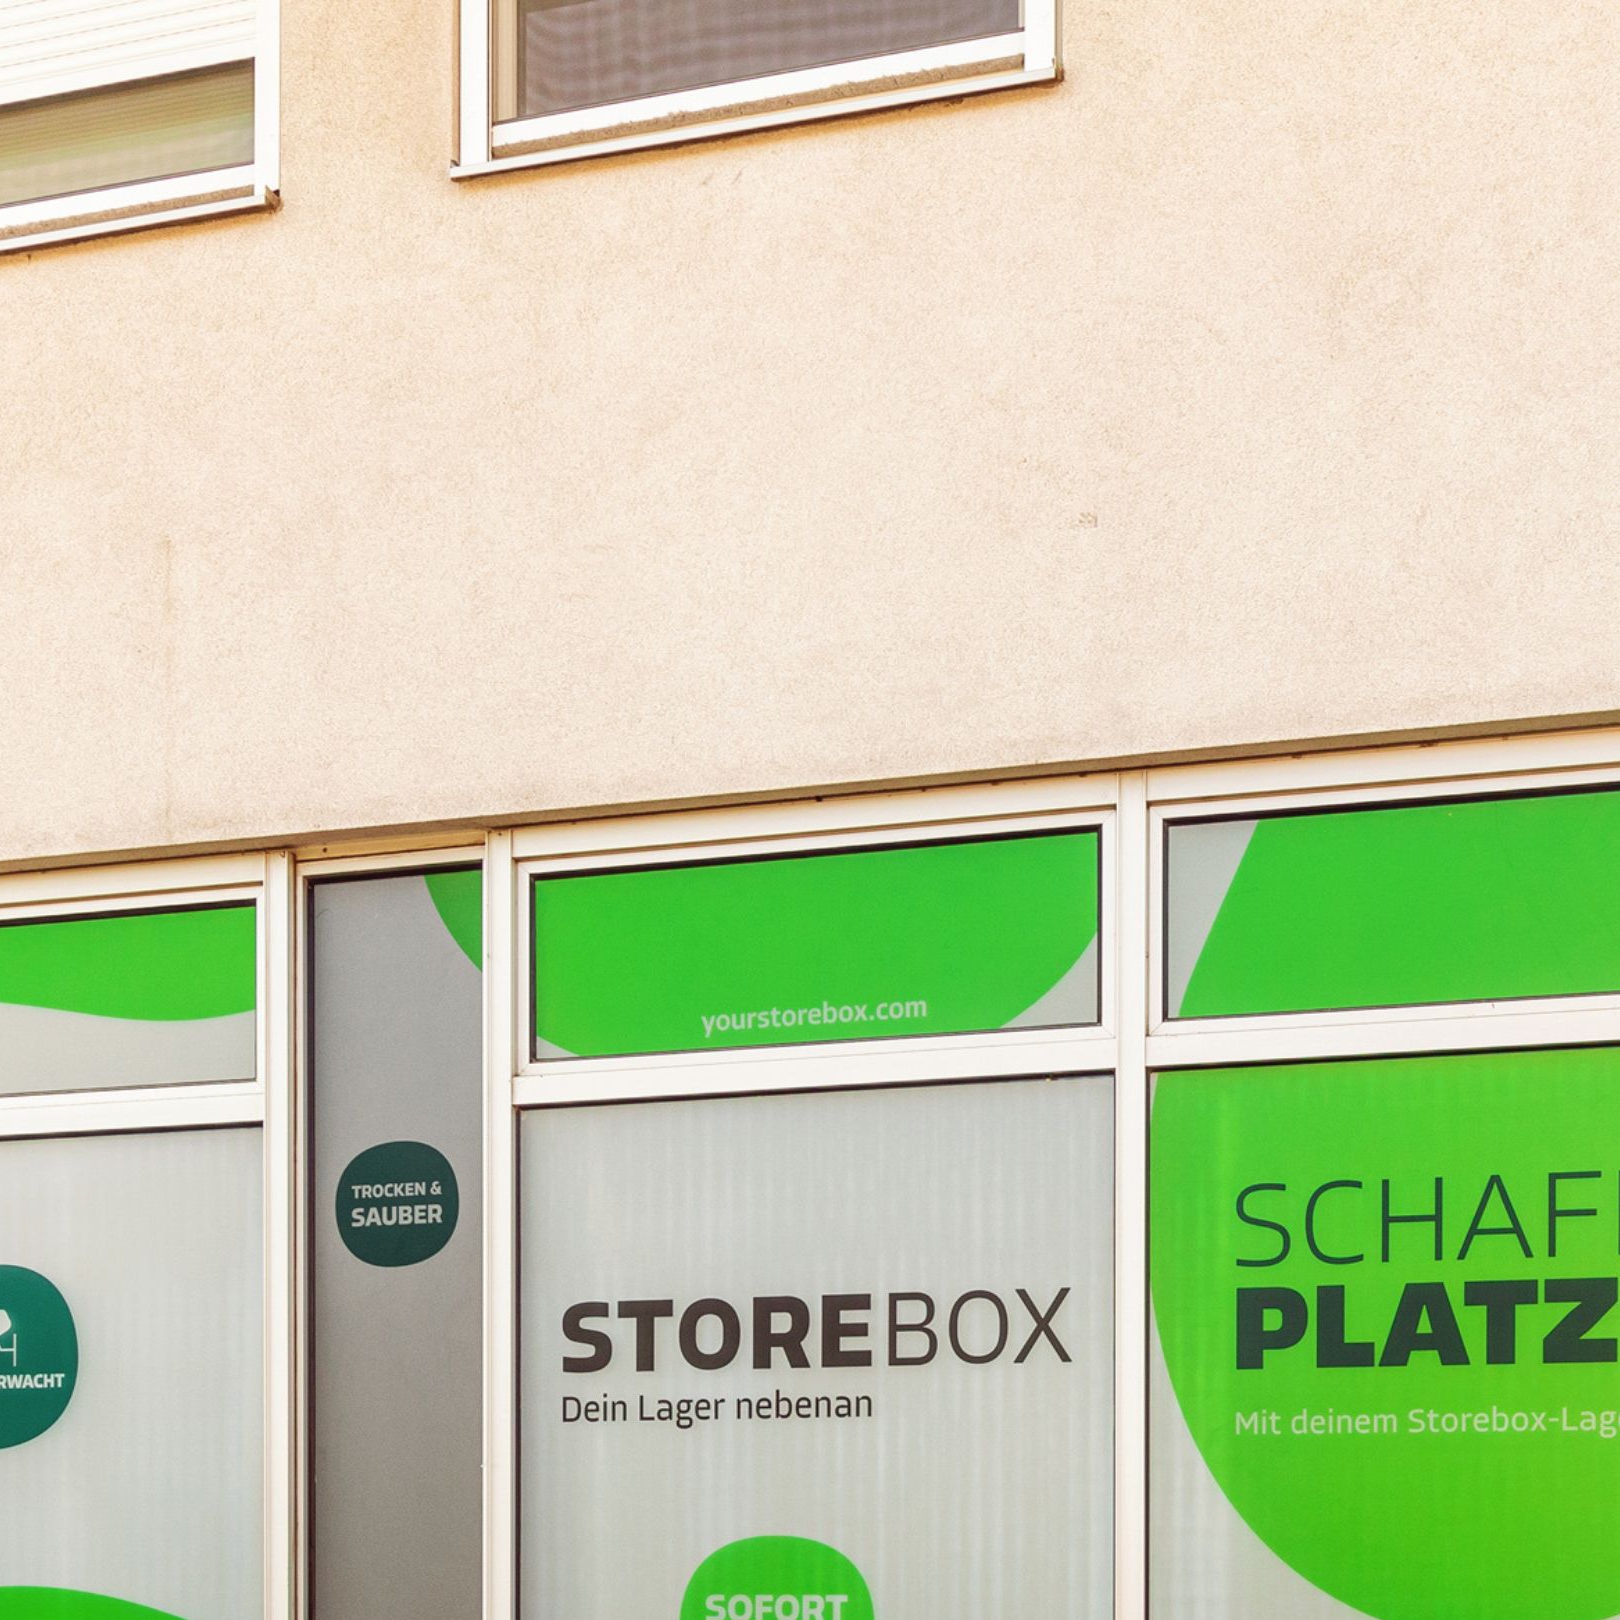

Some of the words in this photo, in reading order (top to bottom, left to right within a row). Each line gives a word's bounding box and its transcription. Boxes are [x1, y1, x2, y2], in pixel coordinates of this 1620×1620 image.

[701, 1000, 927, 1036] yourstorebox.com
[351, 1181, 426, 1199] TROCKEN
[430, 1181, 442, 1195] &
[351, 1203, 443, 1228] SAUBER
[561, 1286, 1073, 1374] STOREBOX
[561, 1393, 628, 1423] Dein
[638, 1394, 722, 1429] Lager
[736, 1388, 873, 1420] nebenan
[1235, 1408, 1282, 1436] Mit
[1291, 1407, 1398, 1435] deinem
